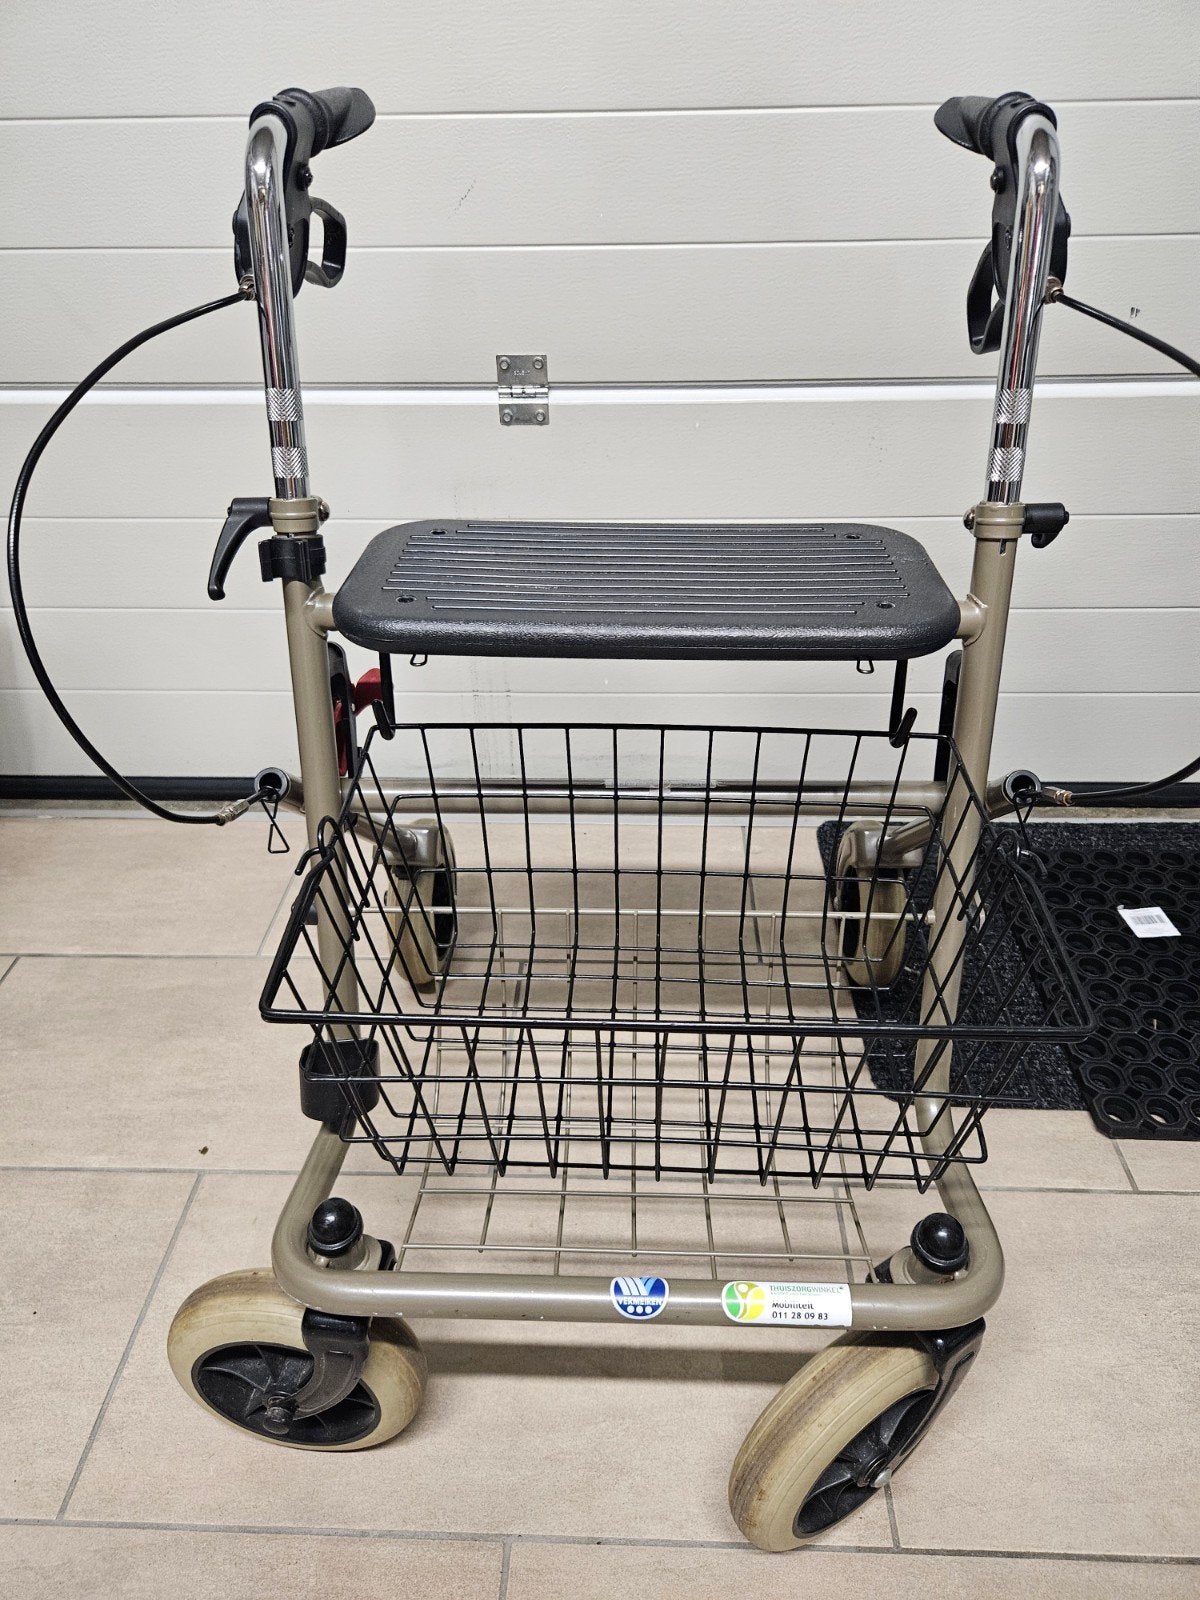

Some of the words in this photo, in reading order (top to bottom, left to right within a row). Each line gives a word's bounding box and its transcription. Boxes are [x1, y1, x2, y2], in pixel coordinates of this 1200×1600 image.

[769, 1285, 841, 1293] THUISZORGWINKEL
[616, 1297, 663, 1306] VERMEIREN
[772, 1311, 787, 1319] 011
[791, 1311, 801, 1320] 28
[804, 1312, 815, 1320] 09
[818, 1312, 828, 1321] 83
